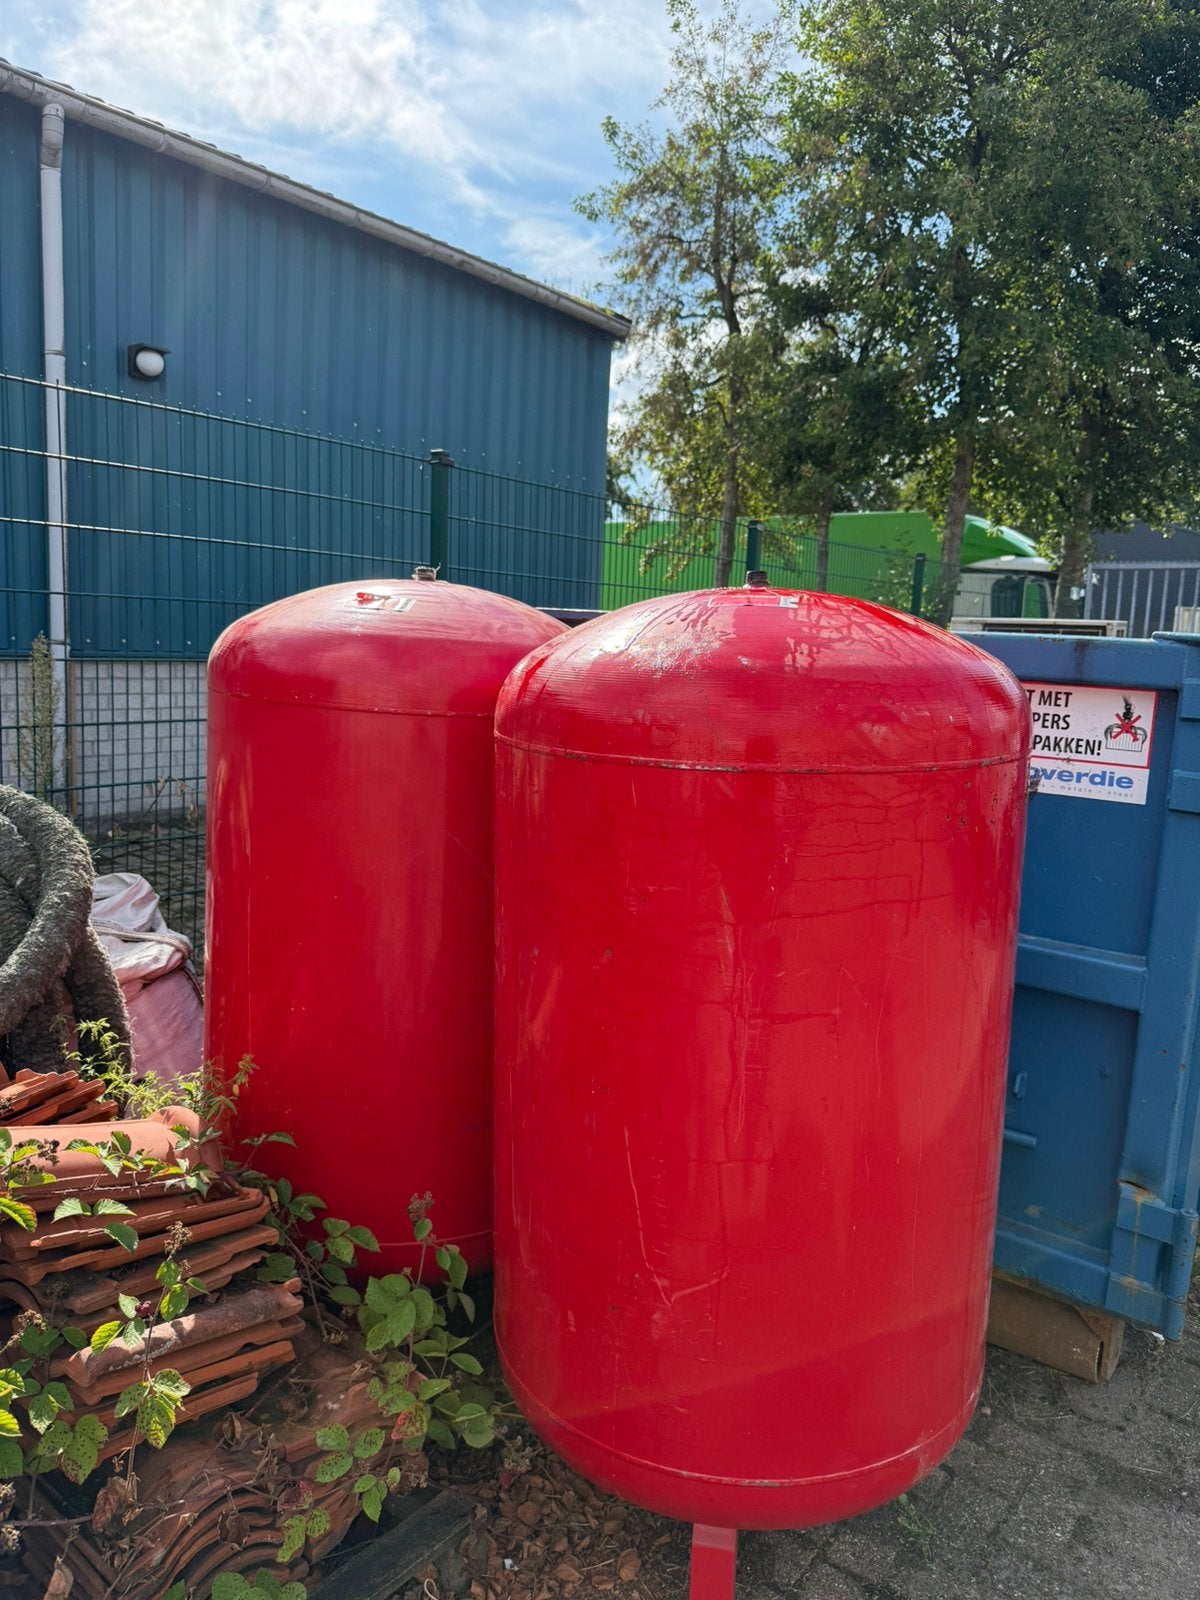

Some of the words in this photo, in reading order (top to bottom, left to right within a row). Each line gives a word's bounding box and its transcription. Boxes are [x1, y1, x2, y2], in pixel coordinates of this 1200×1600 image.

[1038, 690, 1073, 708] MET
[1032, 711, 1071, 730] PERS
[1032, 734, 1102, 756] PAKKEN!
[1029, 767, 1134, 789] overdie
